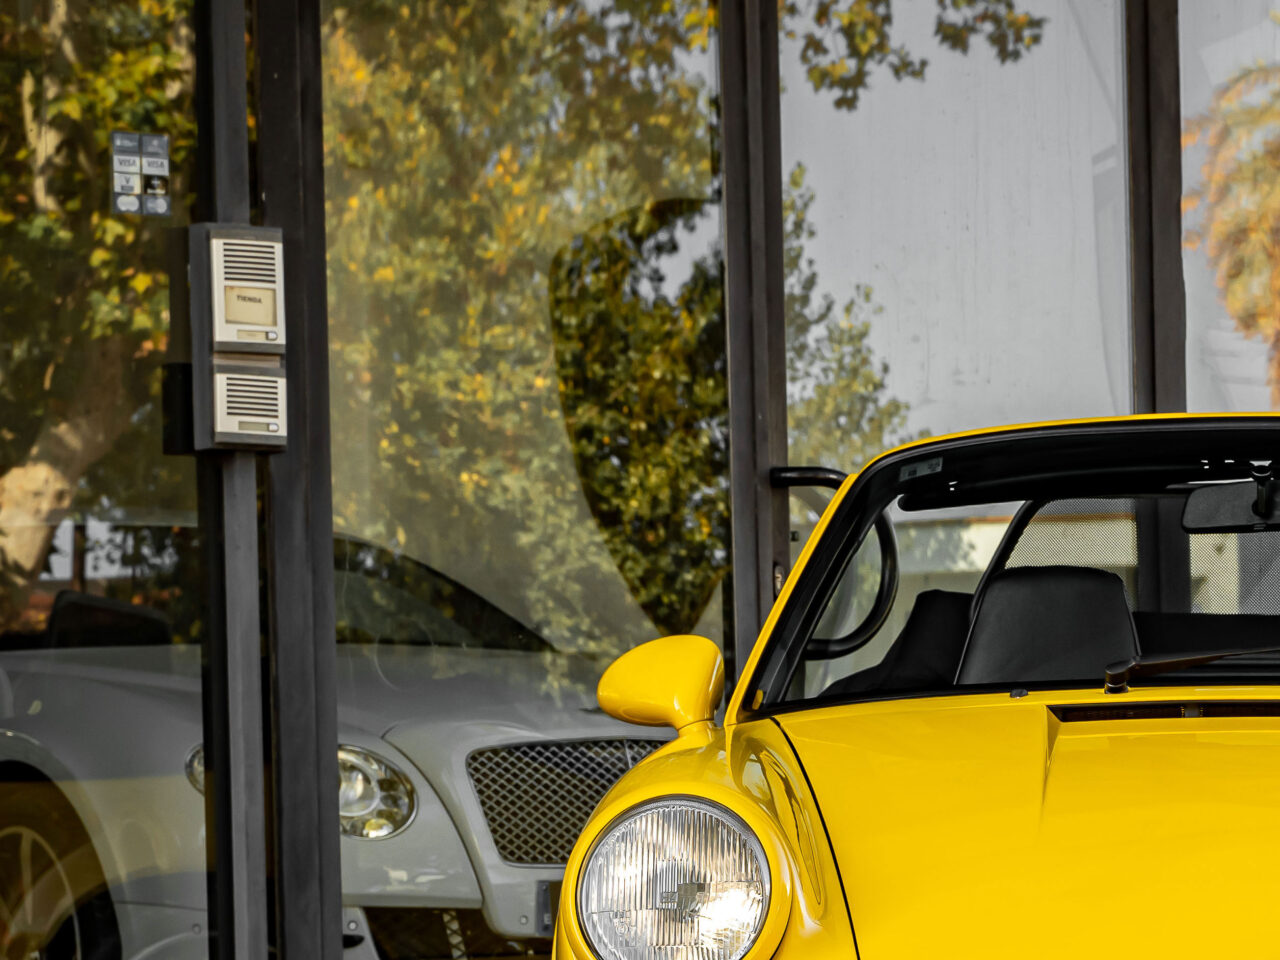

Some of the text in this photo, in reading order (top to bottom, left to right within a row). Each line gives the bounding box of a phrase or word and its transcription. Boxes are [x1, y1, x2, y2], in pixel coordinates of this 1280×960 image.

[118, 158, 137, 167] VISA
[147, 159, 165, 169] VISA
[236, 294, 262, 304] TIENDA
